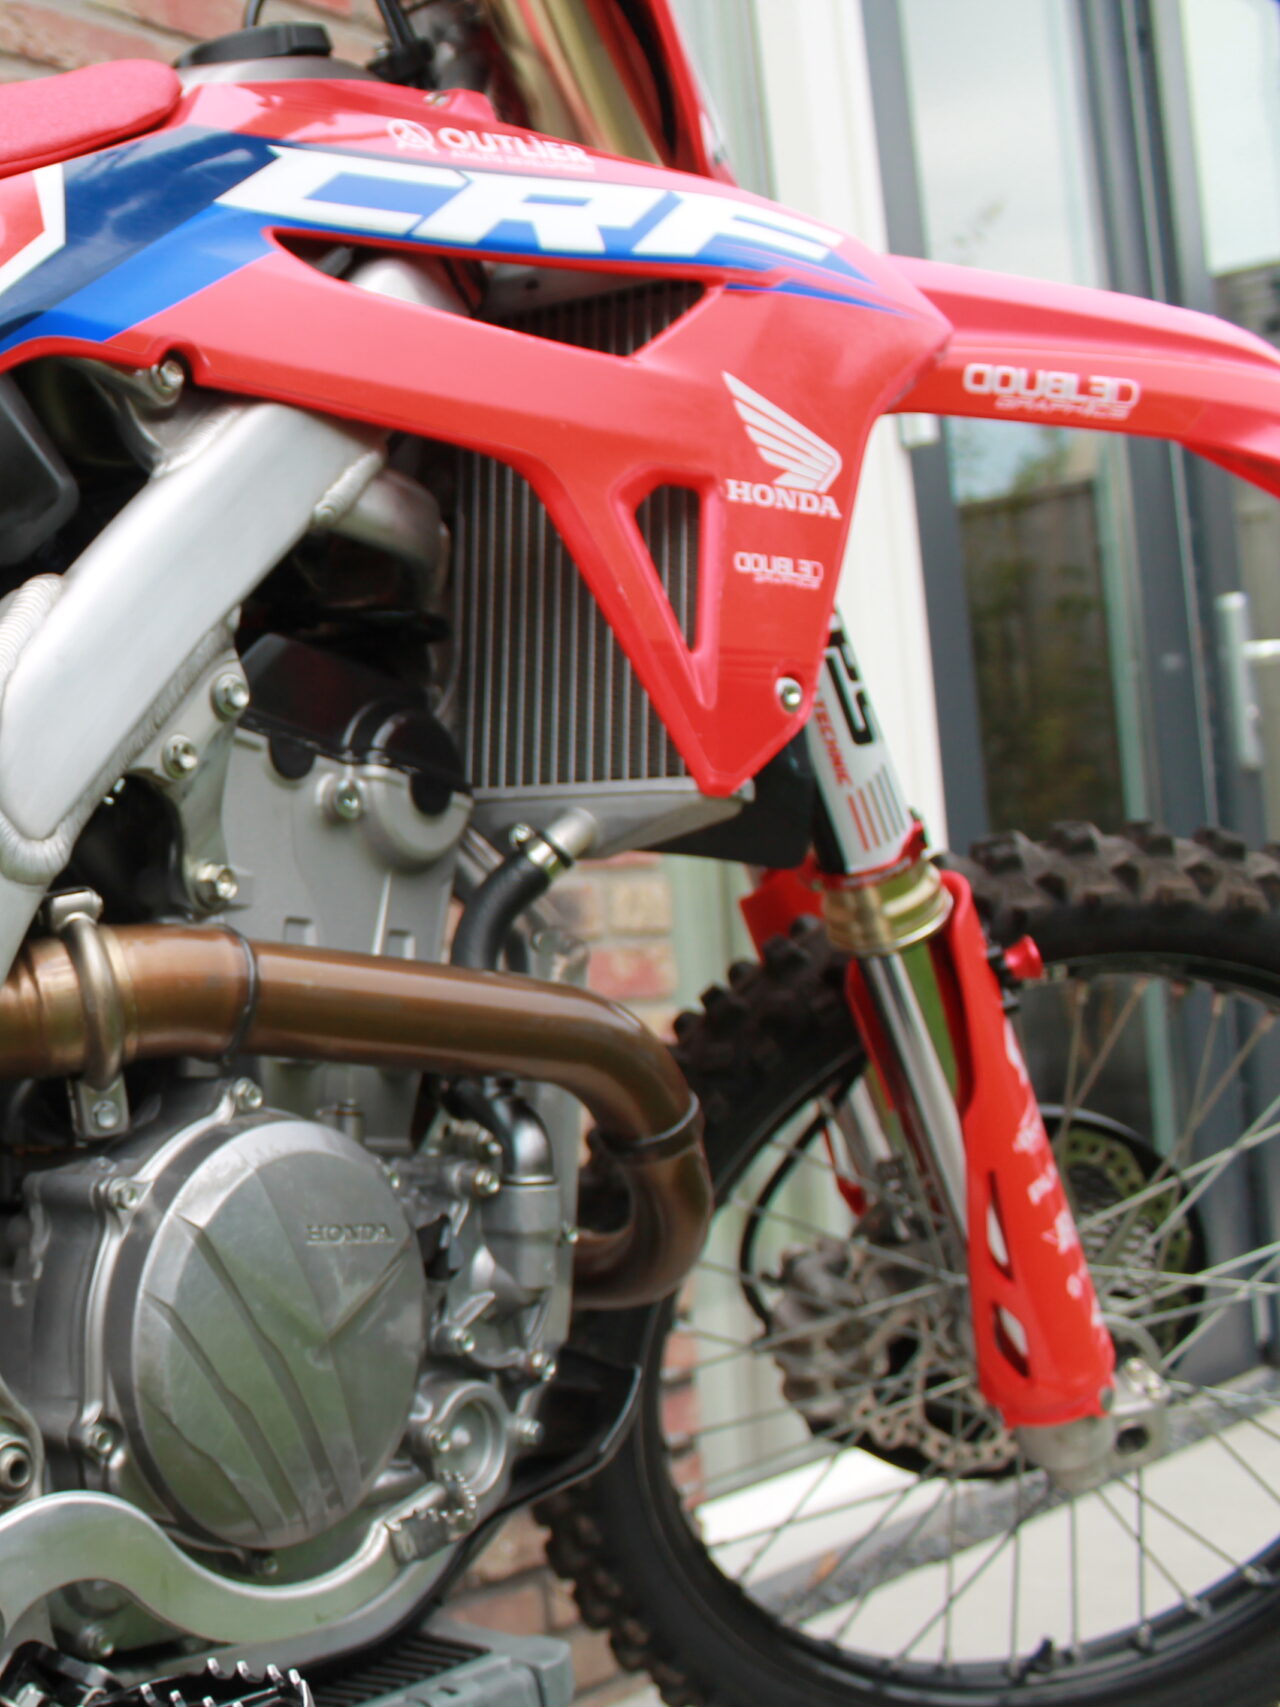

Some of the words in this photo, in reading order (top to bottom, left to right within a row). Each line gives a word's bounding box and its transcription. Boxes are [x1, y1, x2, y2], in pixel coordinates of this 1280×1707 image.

[215, 145, 844, 261] CRF
[725, 478, 843, 519] HONDA
[304, 1223, 395, 1246] HONDA
